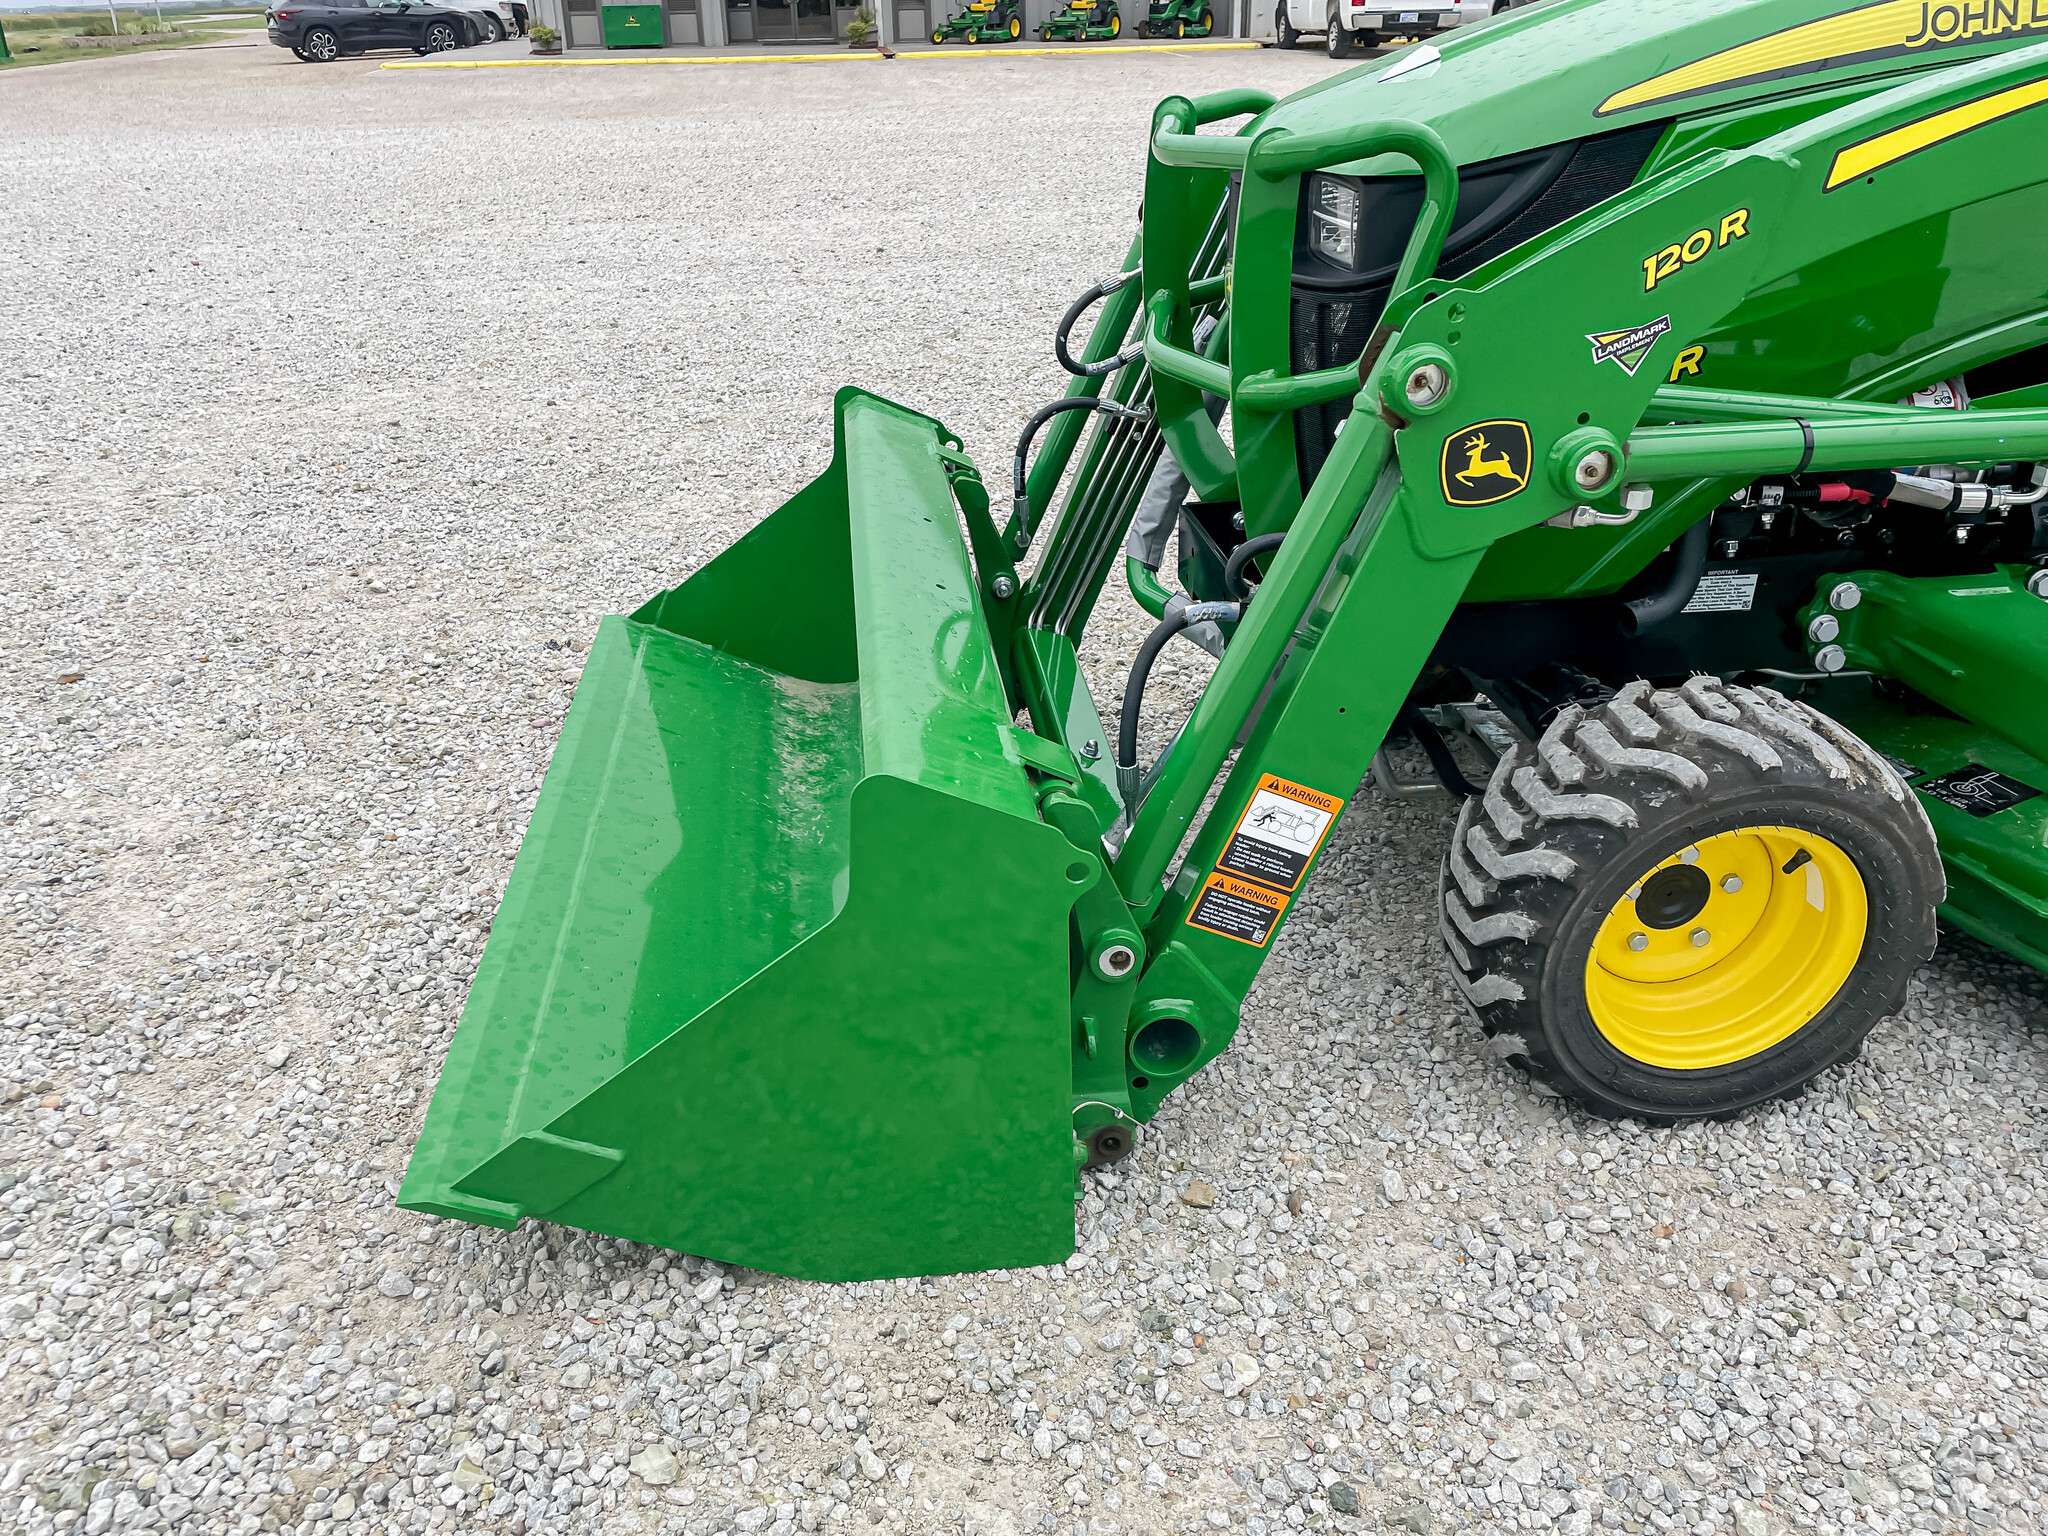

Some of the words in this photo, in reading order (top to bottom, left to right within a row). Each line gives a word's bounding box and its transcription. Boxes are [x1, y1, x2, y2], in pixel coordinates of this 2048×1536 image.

[1905, 0, 2020, 43] JOHN
[1616, 335, 1654, 357] IMPLEMENT
[1282, 784, 1332, 808] WARNING
[1230, 883, 1279, 906] WARNING
